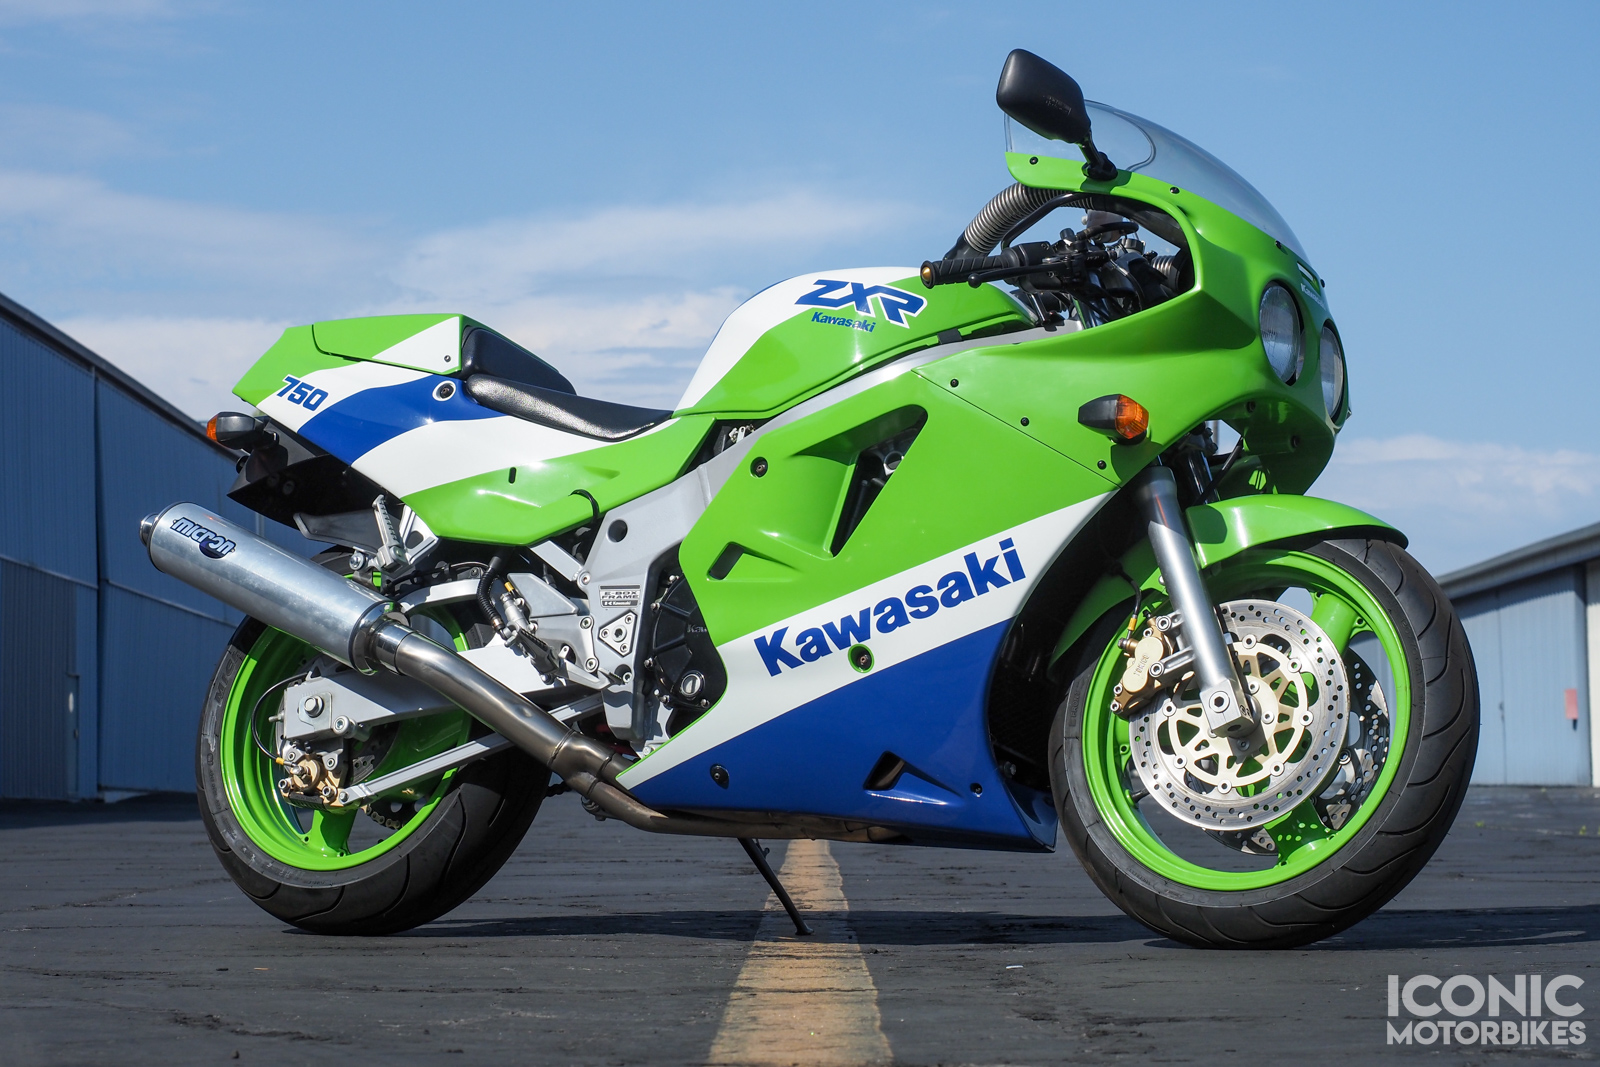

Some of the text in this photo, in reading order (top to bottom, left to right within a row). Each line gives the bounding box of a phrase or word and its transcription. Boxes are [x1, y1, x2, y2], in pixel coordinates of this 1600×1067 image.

[794, 279, 926, 326] ZXR
[811, 311, 877, 333] Kawasaki
[276, 375, 329, 412] 750
[169, 516, 237, 556] micron
[753, 536, 1027, 678] Kawasaki
